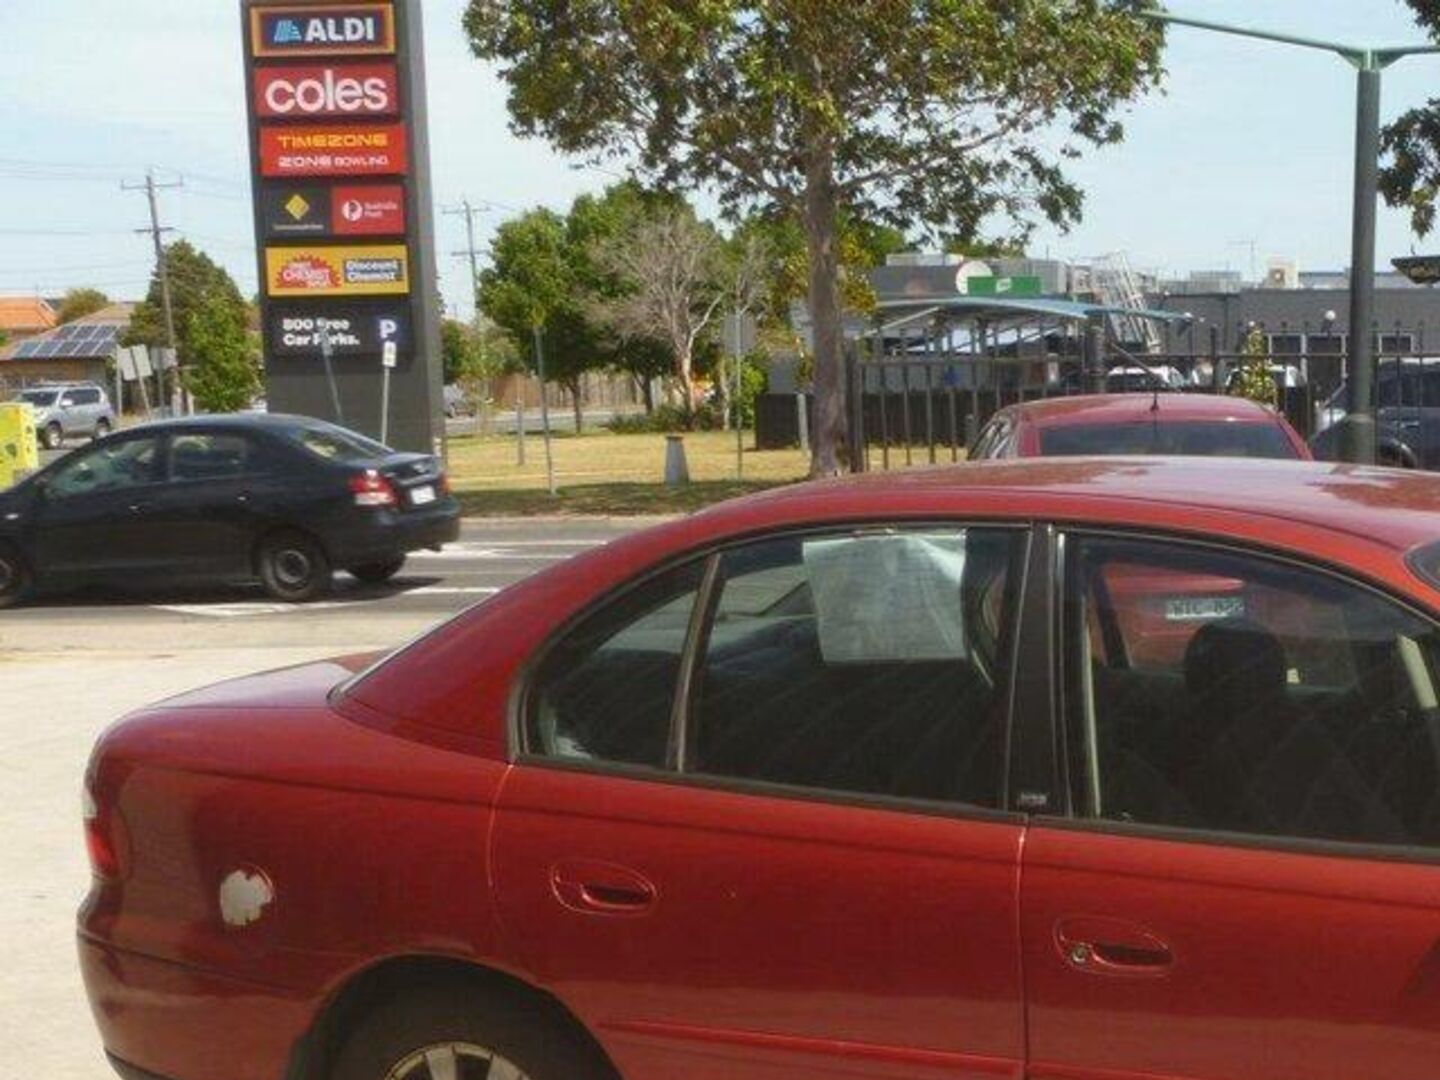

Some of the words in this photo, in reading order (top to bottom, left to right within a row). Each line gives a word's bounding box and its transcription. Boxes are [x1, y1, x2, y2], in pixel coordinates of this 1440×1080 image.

[304, 17, 375, 41] ALDI
[265, 69, 388, 113] coles
[277, 133, 388, 149] TIMEZONE
[278, 155, 331, 167] ZONE
[282, 333, 311, 347] Car
